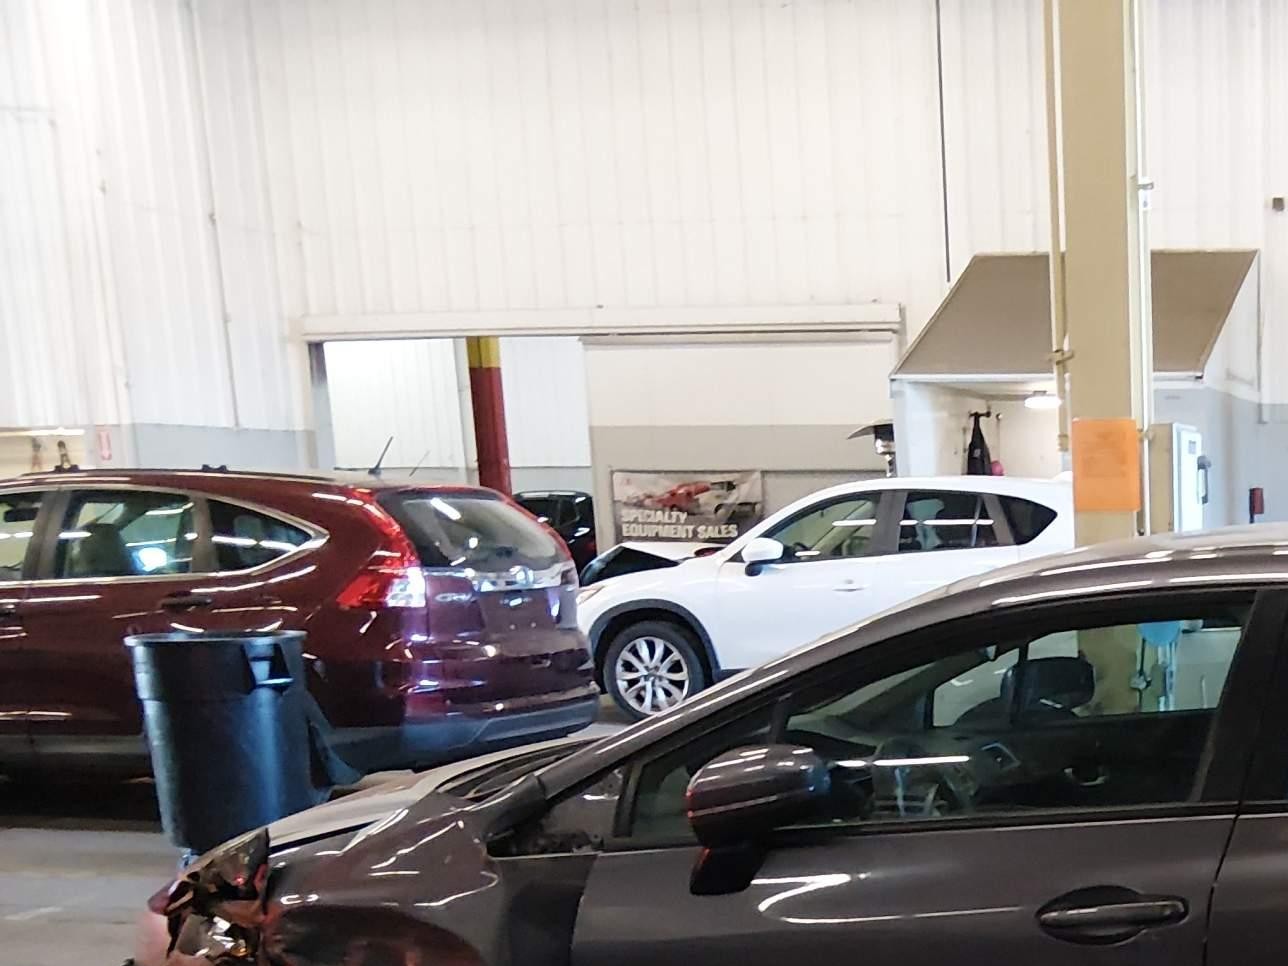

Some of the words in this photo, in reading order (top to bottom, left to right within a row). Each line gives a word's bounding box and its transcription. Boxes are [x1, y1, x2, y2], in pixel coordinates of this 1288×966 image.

[621, 508, 688, 524] SPECIALTY
[621, 523, 696, 538] EQUIPMENT
[696, 523, 738, 539] SALES
